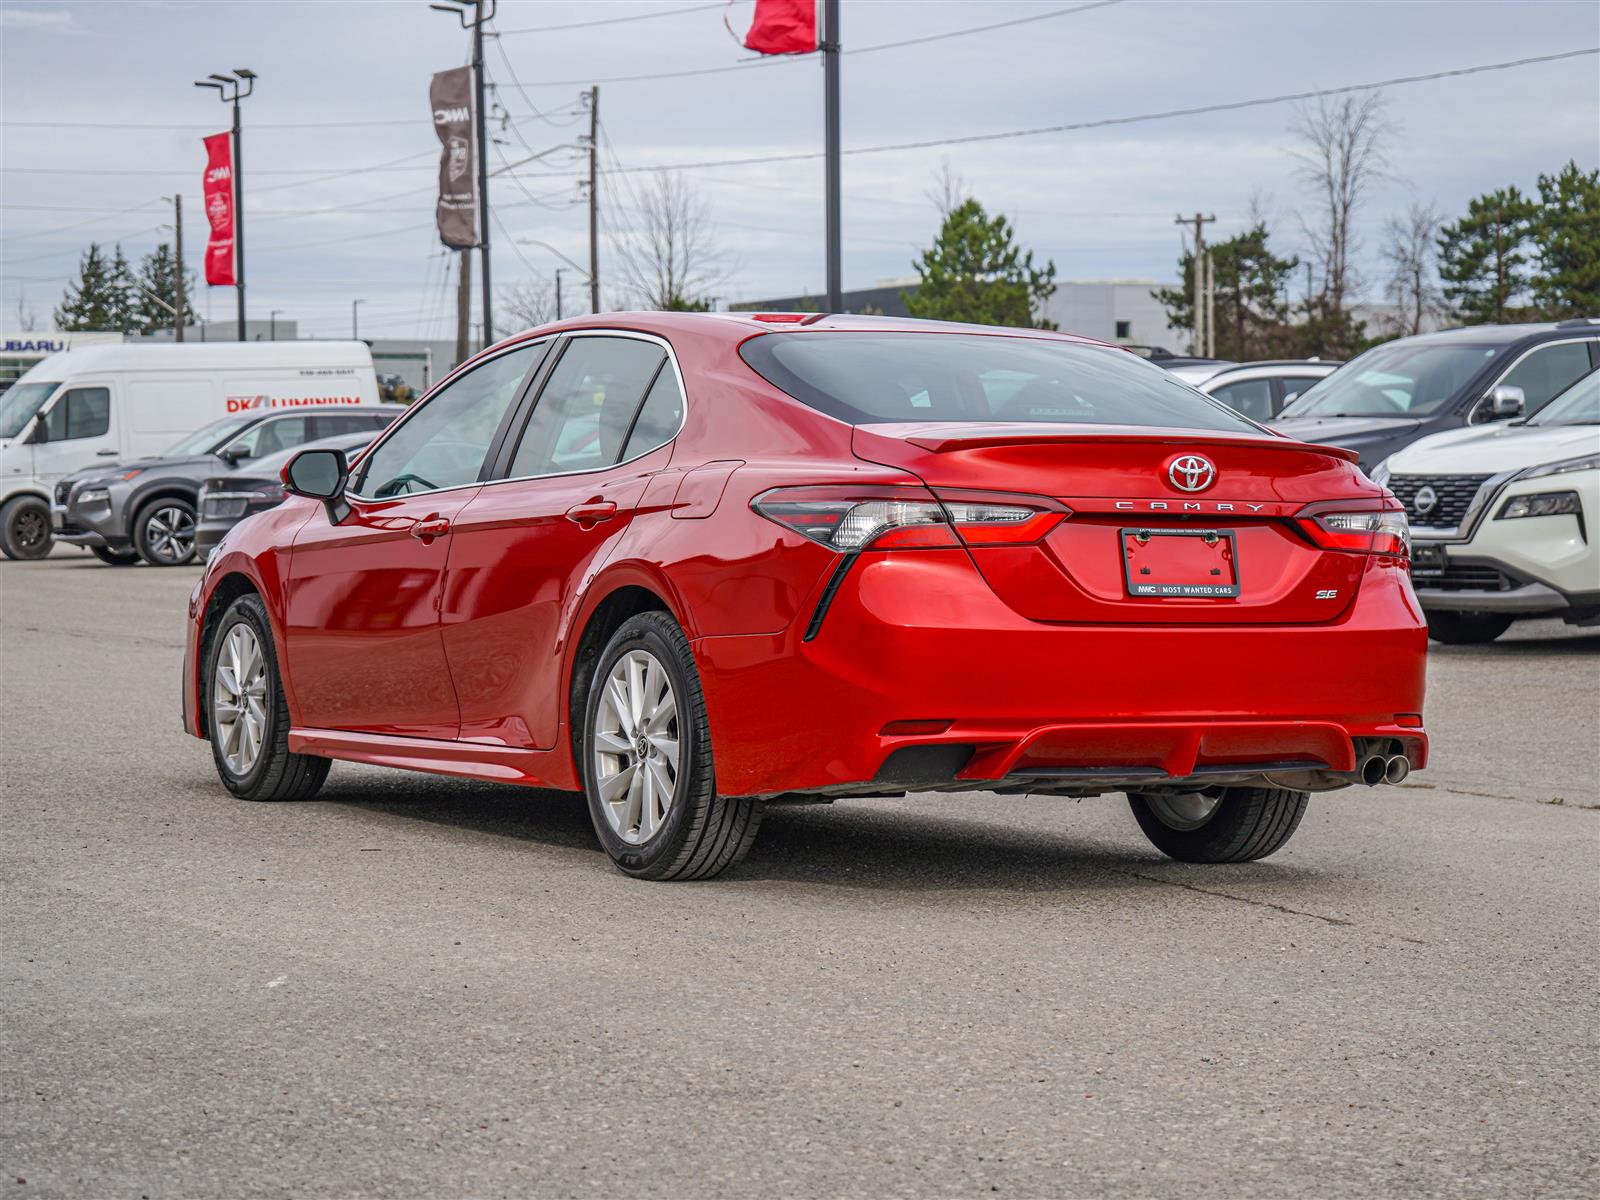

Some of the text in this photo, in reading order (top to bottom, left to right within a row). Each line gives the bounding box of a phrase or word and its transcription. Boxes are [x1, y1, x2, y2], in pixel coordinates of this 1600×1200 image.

[1115, 501, 1265, 512] CAMRY
[1184, 586, 1212, 594] WANTED
[1315, 589, 1338, 600] SE
